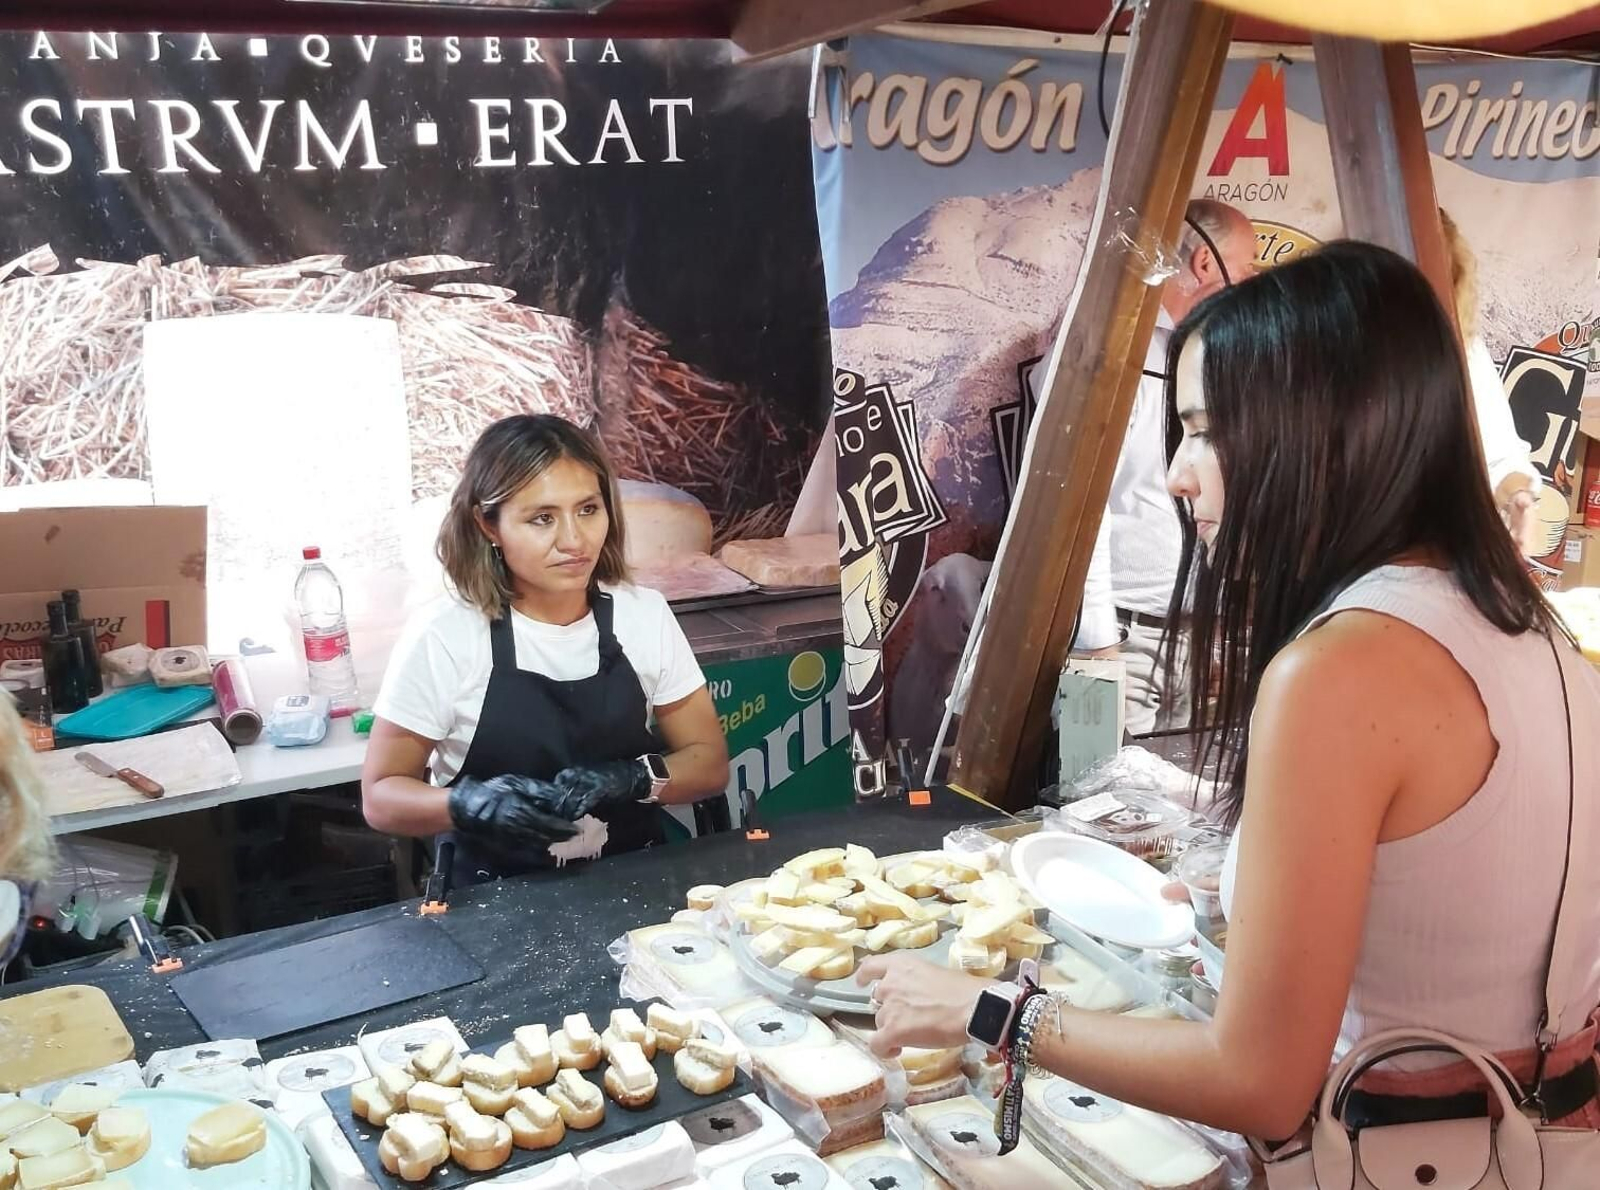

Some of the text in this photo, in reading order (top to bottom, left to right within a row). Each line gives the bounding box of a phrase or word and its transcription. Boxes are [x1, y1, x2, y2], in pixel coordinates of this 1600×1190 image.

[301, 33, 622, 68] QVESERIA
[468, 97, 693, 167] ERAT
[1202, 178, 1290, 203] ARAGÓN
